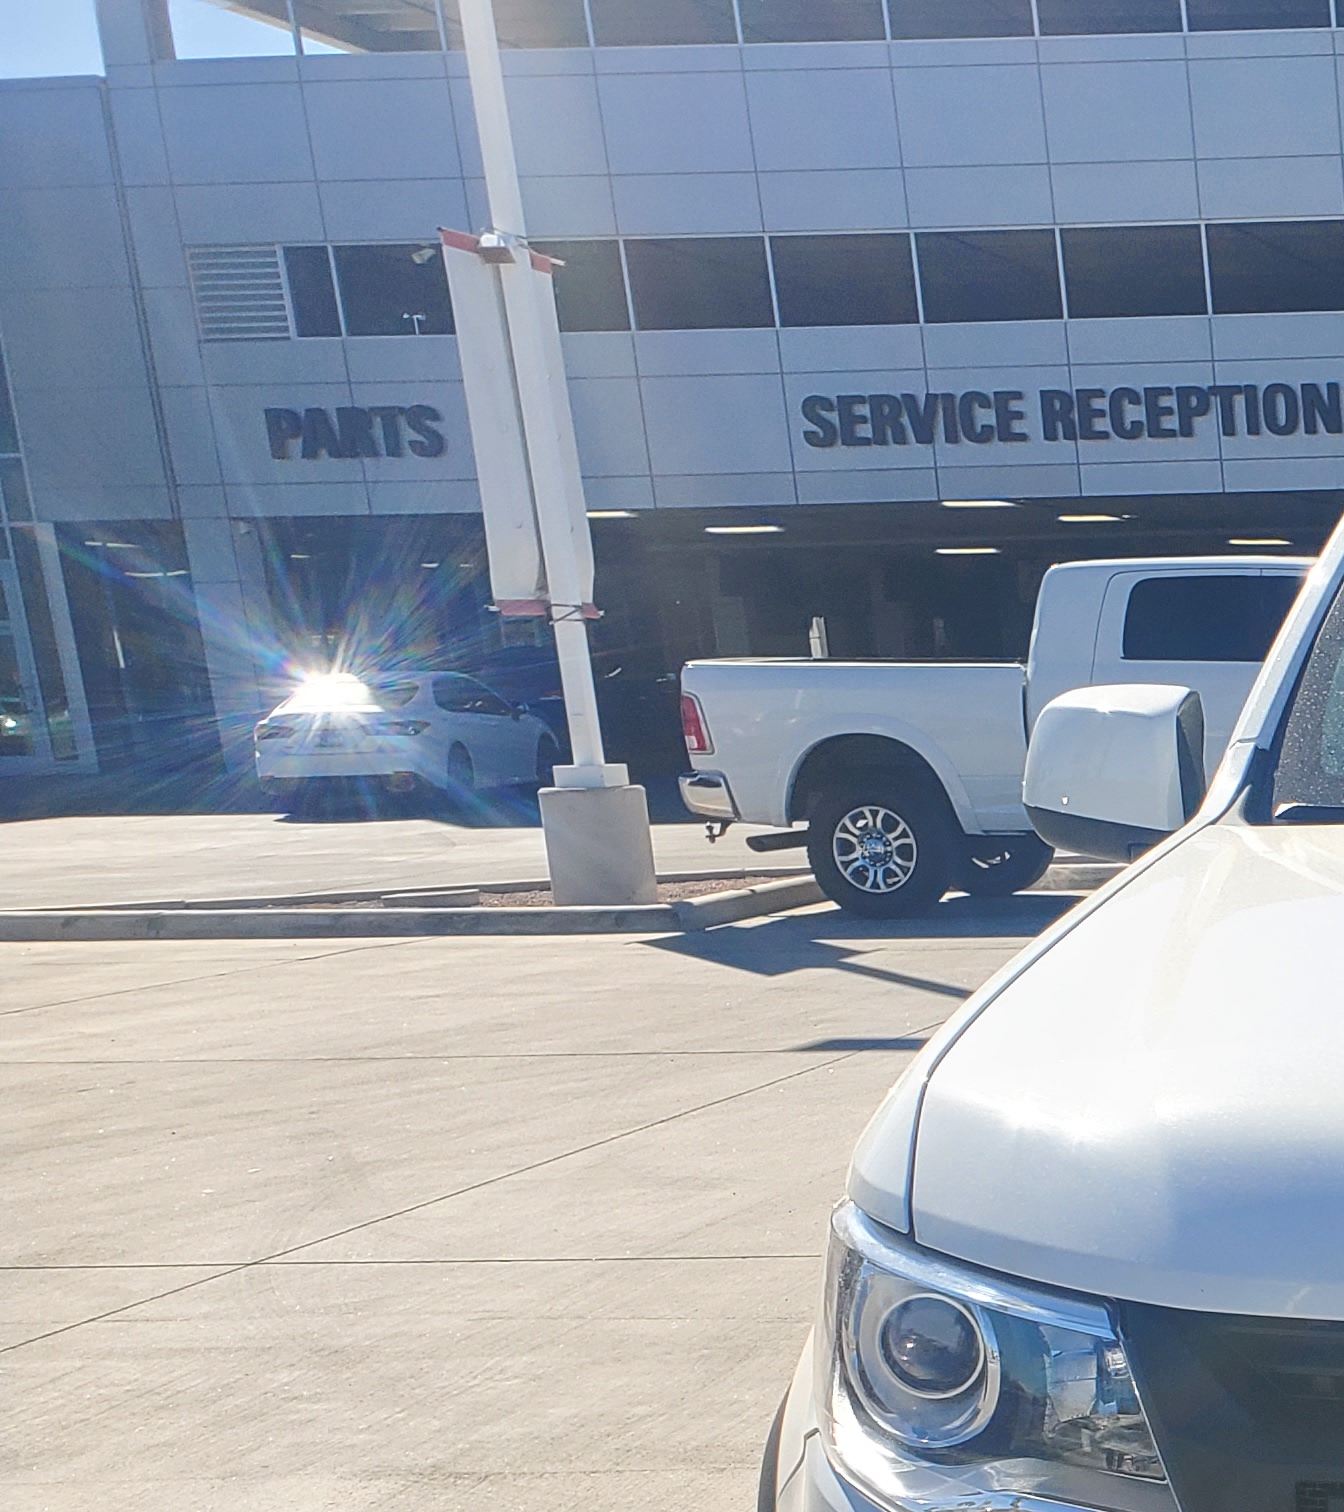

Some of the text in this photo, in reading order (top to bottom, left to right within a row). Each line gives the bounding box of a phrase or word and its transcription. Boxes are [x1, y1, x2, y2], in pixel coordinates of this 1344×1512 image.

[264, 403, 447, 460] PARTS
[800, 381, 1344, 448] SERVICE RECEPTION
